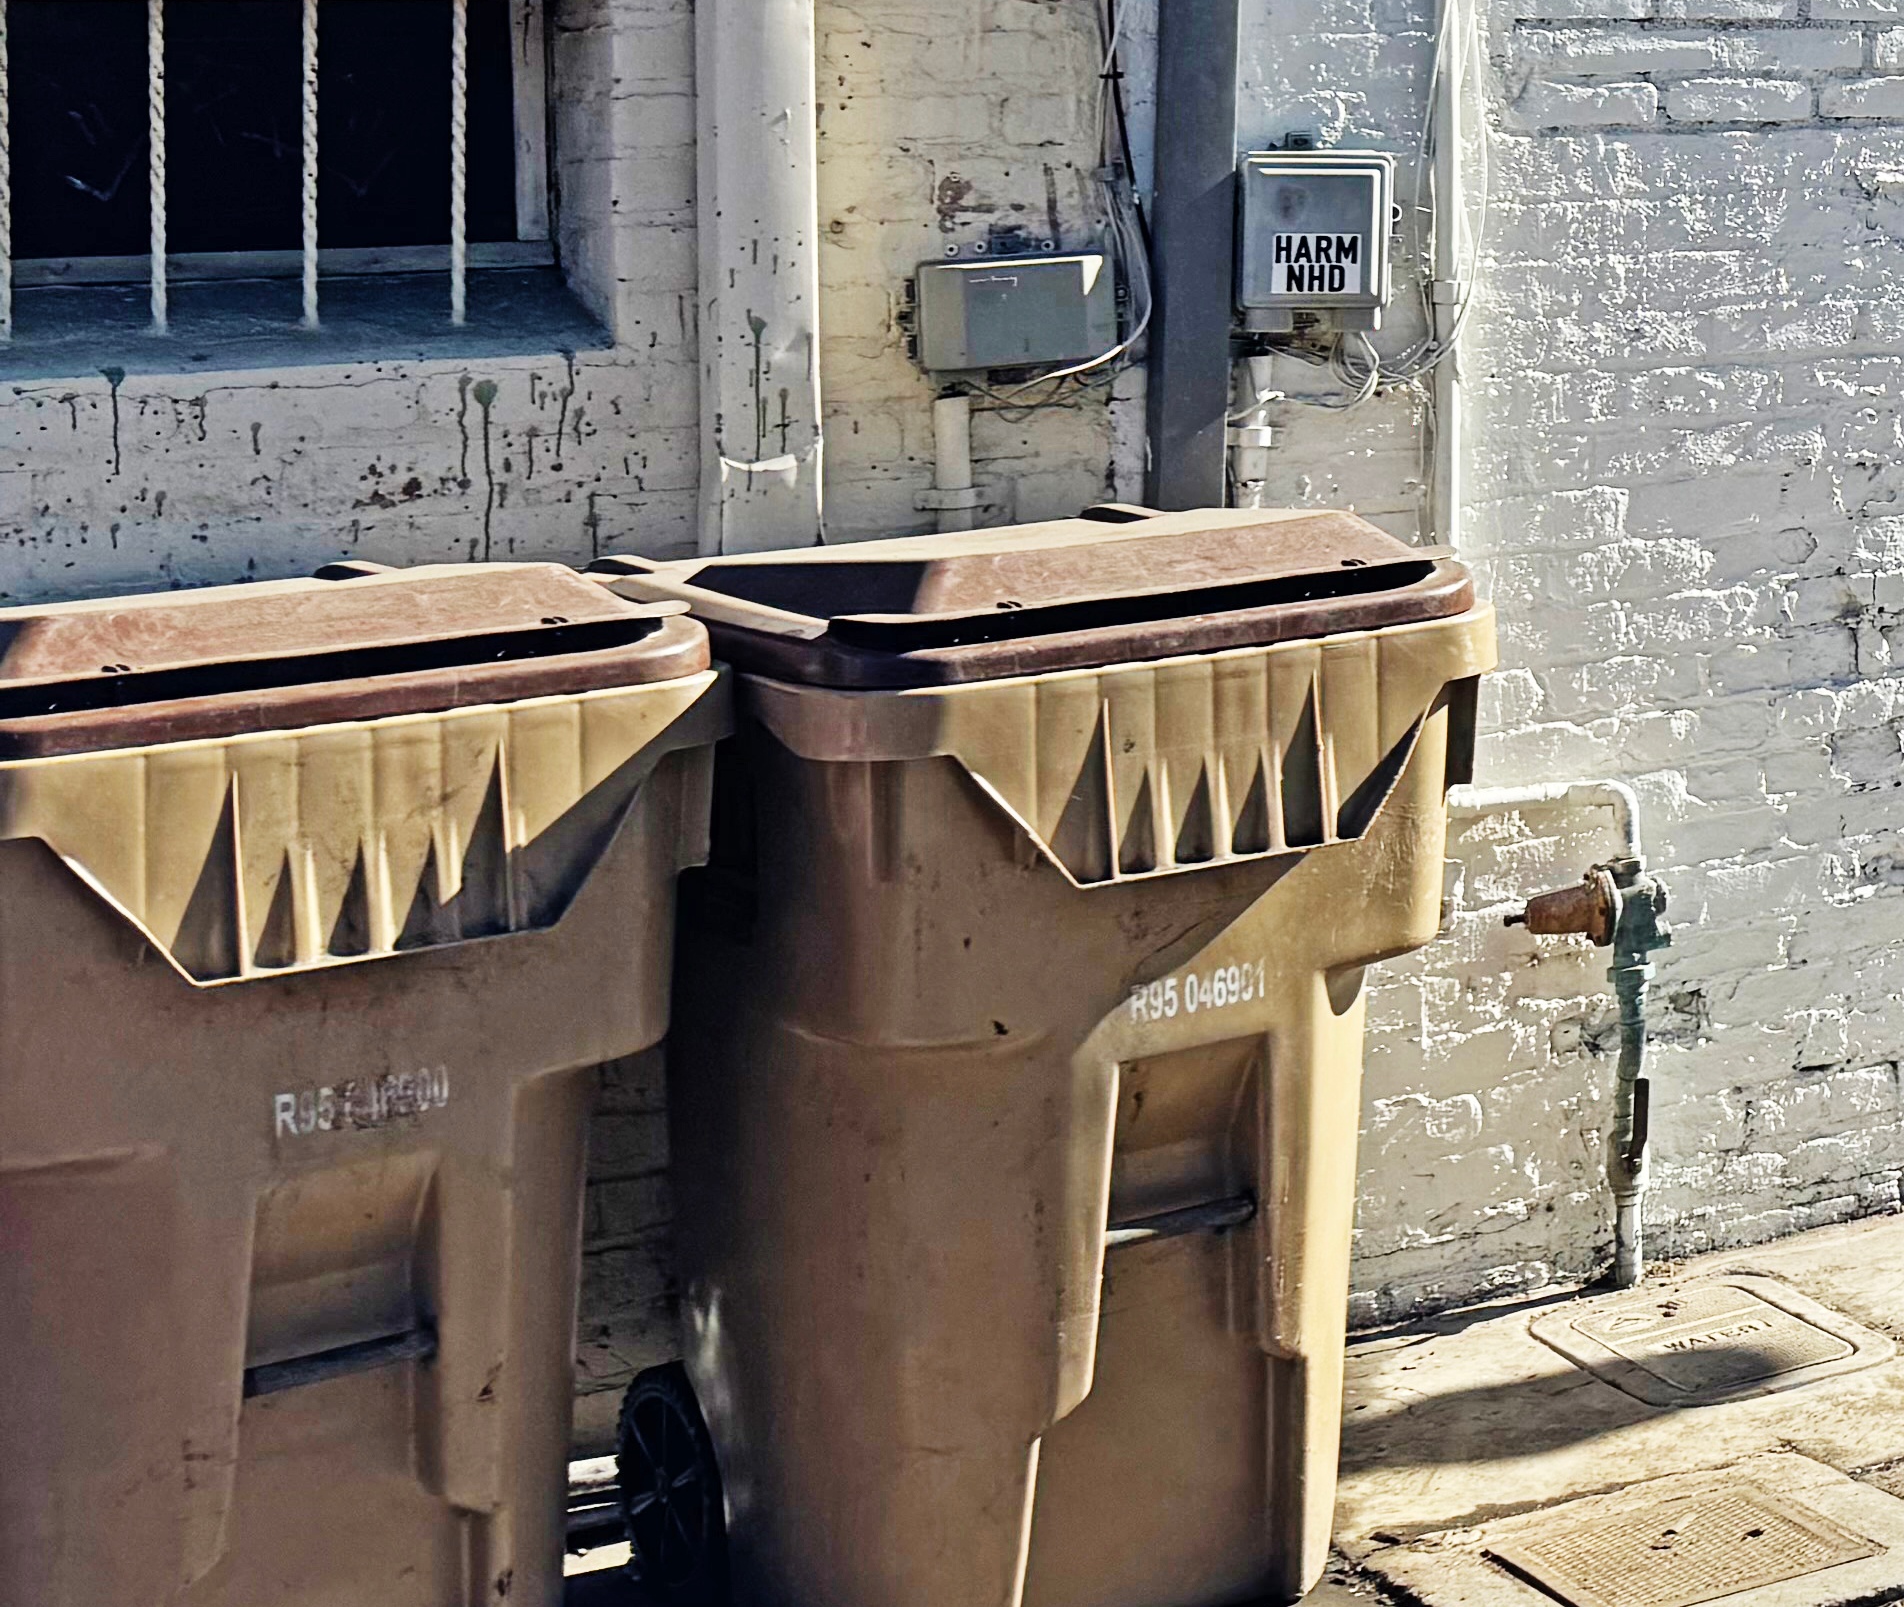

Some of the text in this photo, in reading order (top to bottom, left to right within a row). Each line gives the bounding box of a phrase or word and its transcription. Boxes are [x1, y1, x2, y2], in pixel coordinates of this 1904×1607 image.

[1275, 235, 1359, 264] HARM
[1286, 264, 1345, 292] NHD
[1130, 978, 1178, 1025] R95
[275, 1087, 335, 1138] R95
